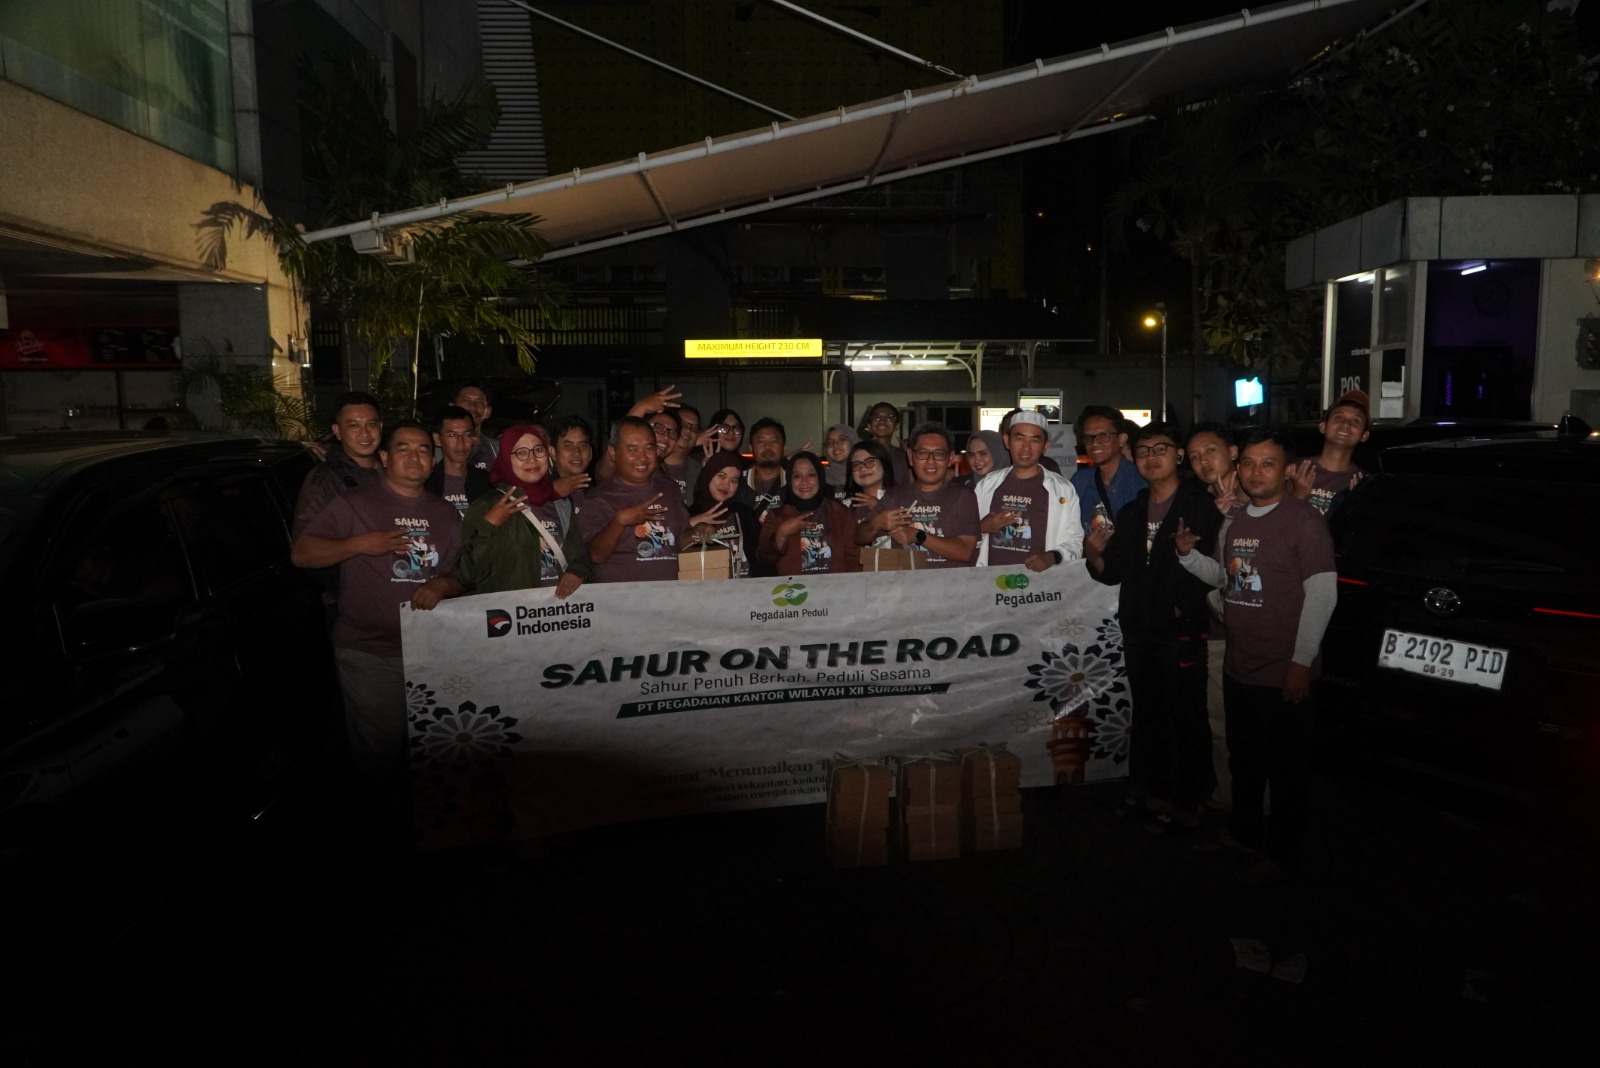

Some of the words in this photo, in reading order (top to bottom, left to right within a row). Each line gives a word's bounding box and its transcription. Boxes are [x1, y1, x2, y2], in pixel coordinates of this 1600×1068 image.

[697, 343, 743, 351] MAXIMUM
[745, 342, 776, 350] HEIGHT
[778, 342, 794, 350] 230
[796, 342, 810, 350] CM
[1002, 495, 1032, 504] SAHUR
[911, 505, 941, 513] SAHUR
[394, 517, 430, 527] SAHUR
[1233, 537, 1260, 547] SAHUR
[996, 591, 1062, 607] Pegadaian
[516, 602, 594, 620] Danantara
[750, 609, 799, 622] Pegadaian
[802, 608, 828, 618] Peduli
[517, 616, 591, 635] Indonesia
[540, 650, 711, 688] SAHUR
[719, 645, 789, 670] ON
[800, 640, 888, 669] THE
[896, 633, 1020, 663] ROAD
[1384, 633, 1398, 655] B
[1404, 637, 1454, 666] 2192
[1464, 647, 1503, 674] PID
[640, 680, 688, 695] Sahur
[694, 674, 743, 690] Penuh
[816, 671, 864, 683] Peduli
[870, 669, 931, 682] Sesama
[637, 703, 655, 713] PT
[657, 696, 731, 711] PEGADAIAN
[734, 691, 785, 704] KANTOR
[788, 687, 845, 699] WILAYAH
[848, 686, 864, 696] XII
[867, 684, 933, 695] SURABAYA
